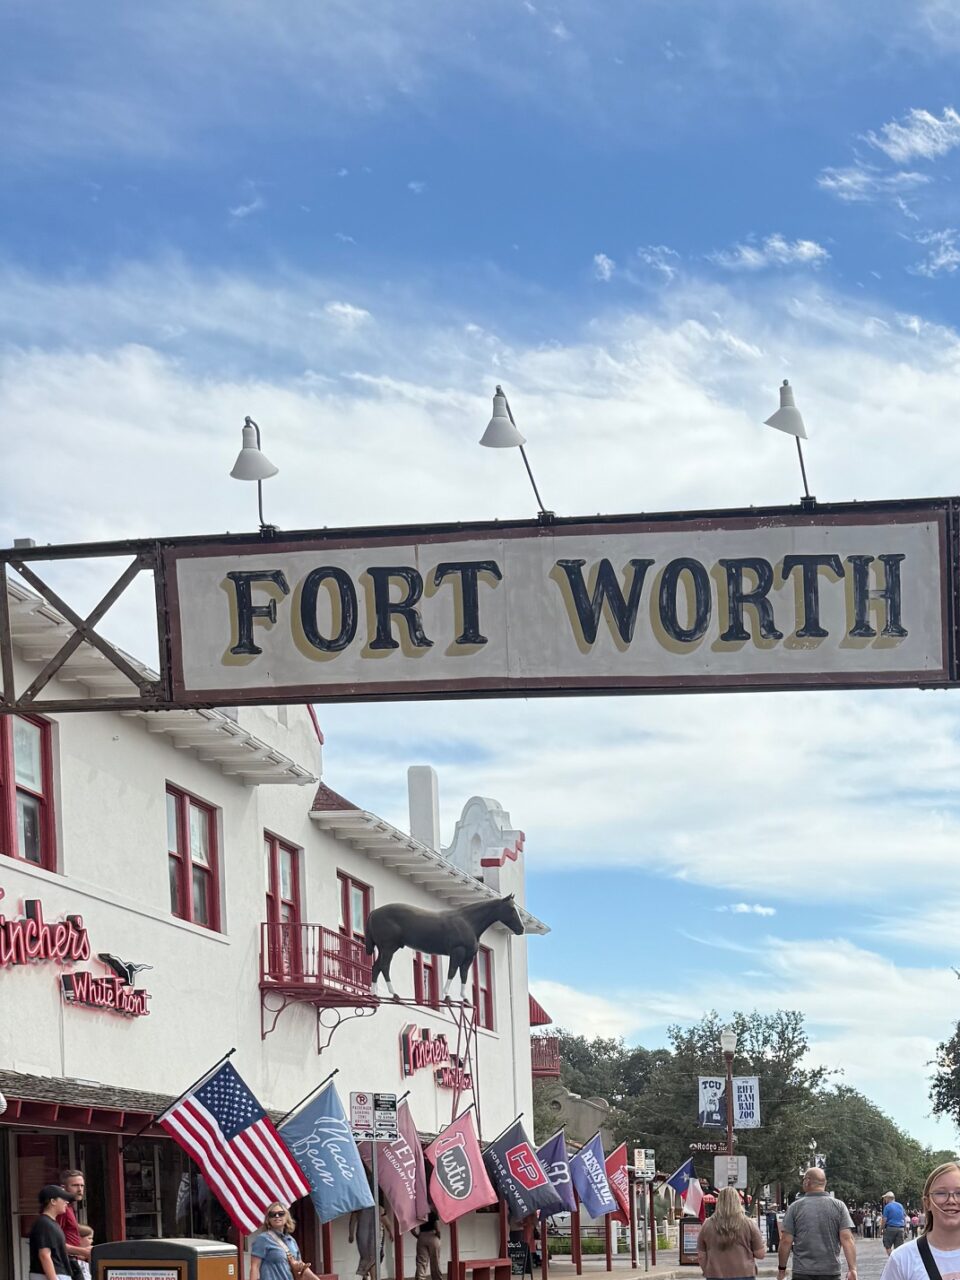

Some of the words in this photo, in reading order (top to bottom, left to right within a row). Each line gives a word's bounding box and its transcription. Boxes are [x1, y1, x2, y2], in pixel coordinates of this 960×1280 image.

[221, 560, 502, 666] FORT
[549, 553, 908, 655] WORTH
[0, 889, 91, 966] incher's
[702, 1081, 721, 1090] TCU
[737, 1085, 754, 1093] RIFF
[737, 1094, 755, 1102] RAM
[739, 1110, 755, 1119] ZOO
[292, 1128, 335, 1187] Bean
[314, 1116, 354, 1181] Macie
[436, 1132, 466, 1195] Justin
[697, 1142, 717, 1152] Rodeo
[489, 1149, 507, 1176] HORSE
[506, 1178, 528, 1213] POWER
[581, 1149, 611, 1205] RESISTOL
